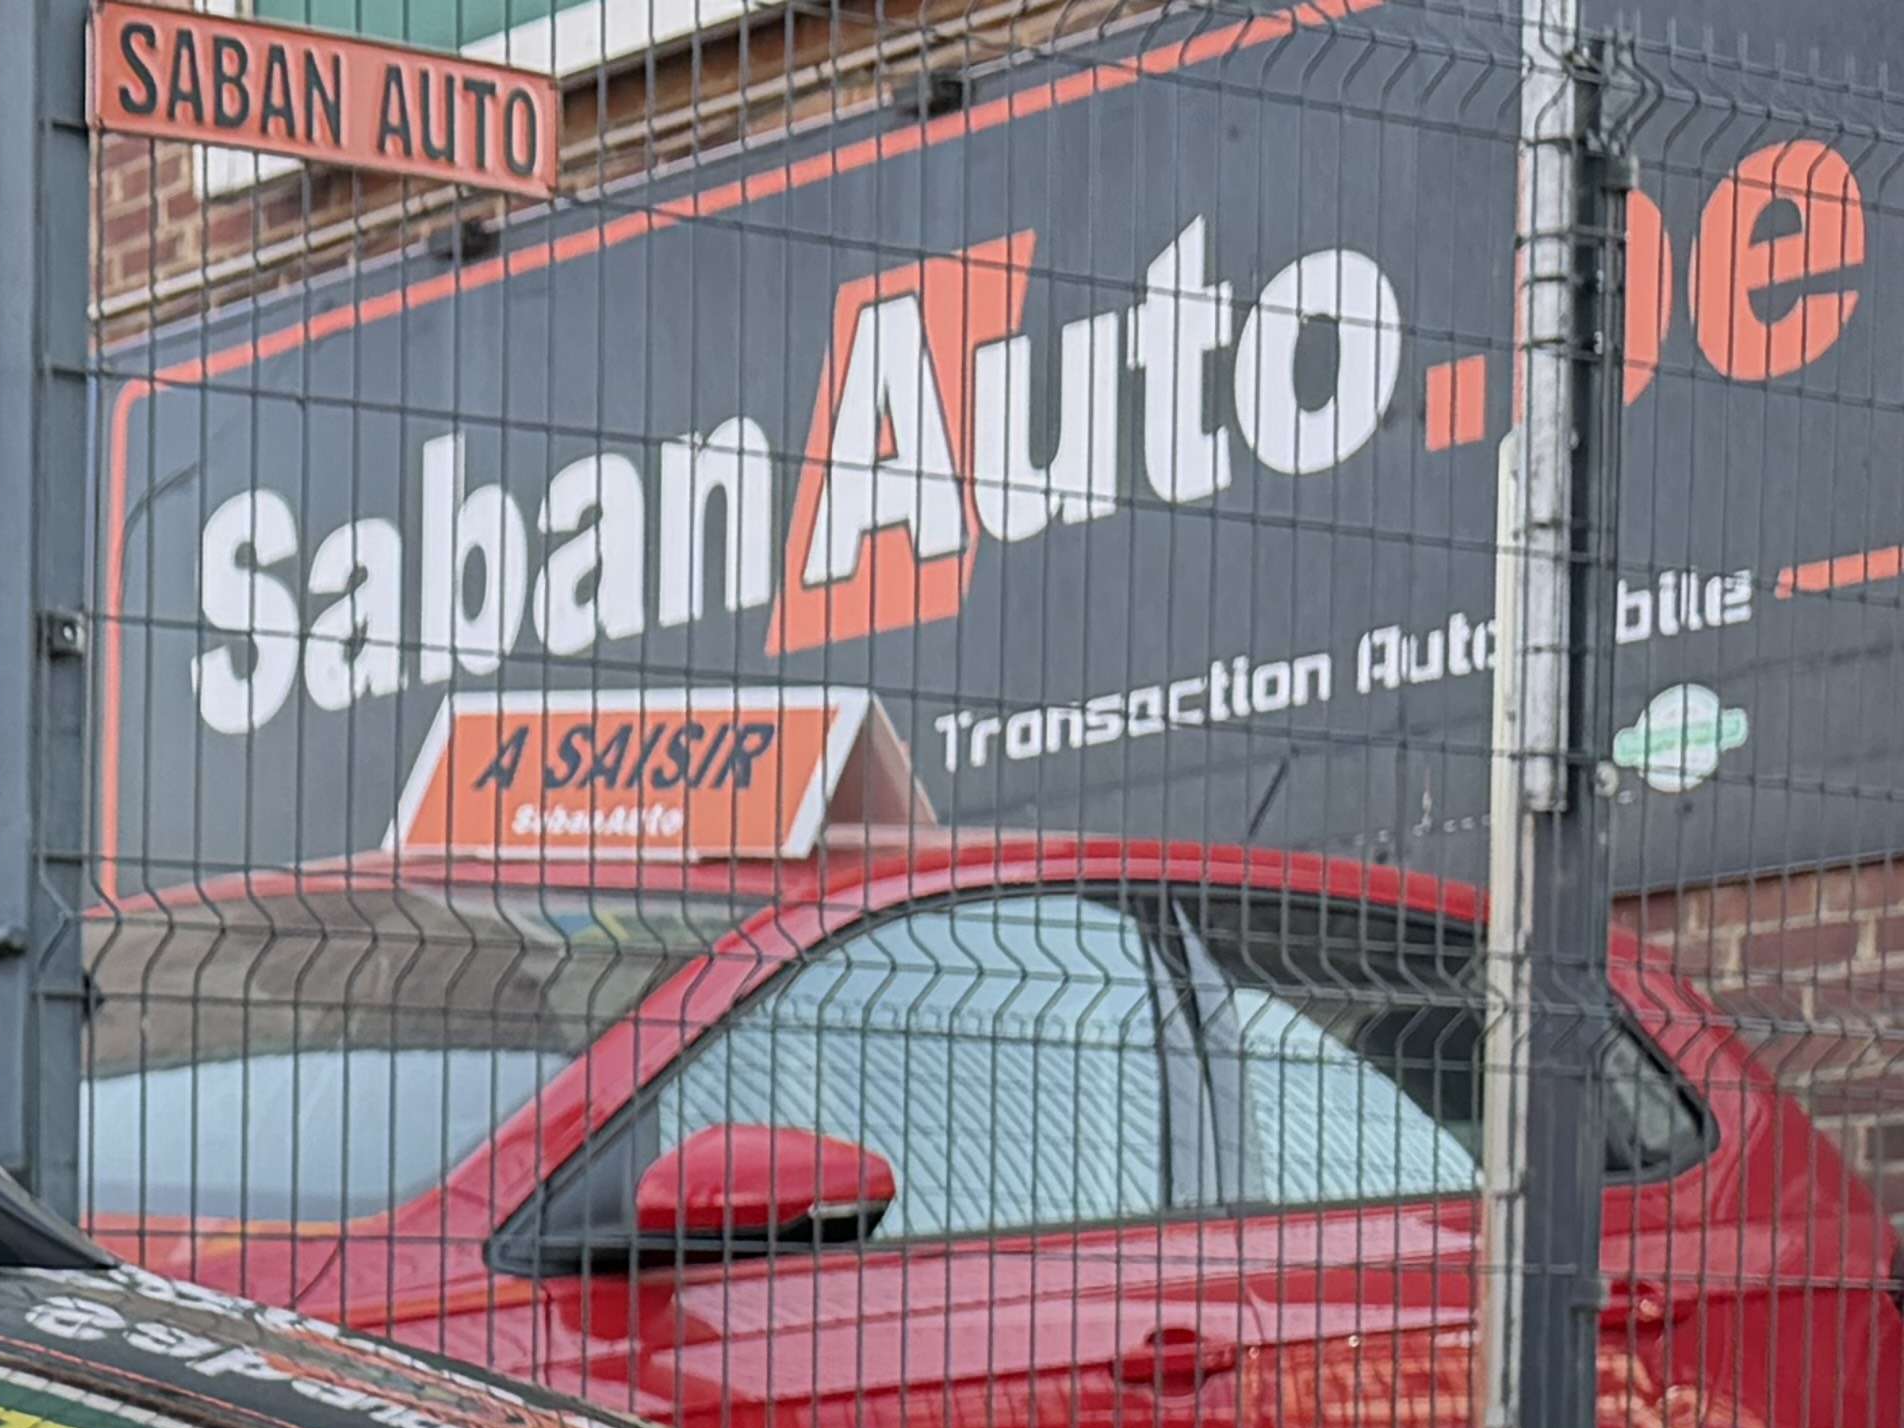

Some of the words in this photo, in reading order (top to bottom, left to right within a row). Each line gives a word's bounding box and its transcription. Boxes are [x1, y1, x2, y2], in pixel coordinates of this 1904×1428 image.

[117, 21, 342, 149] SABAN
[376, 62, 538, 177] AUTO
[542, 720, 777, 793] SAISIR
[934, 650, 1332, 774] Transaction
